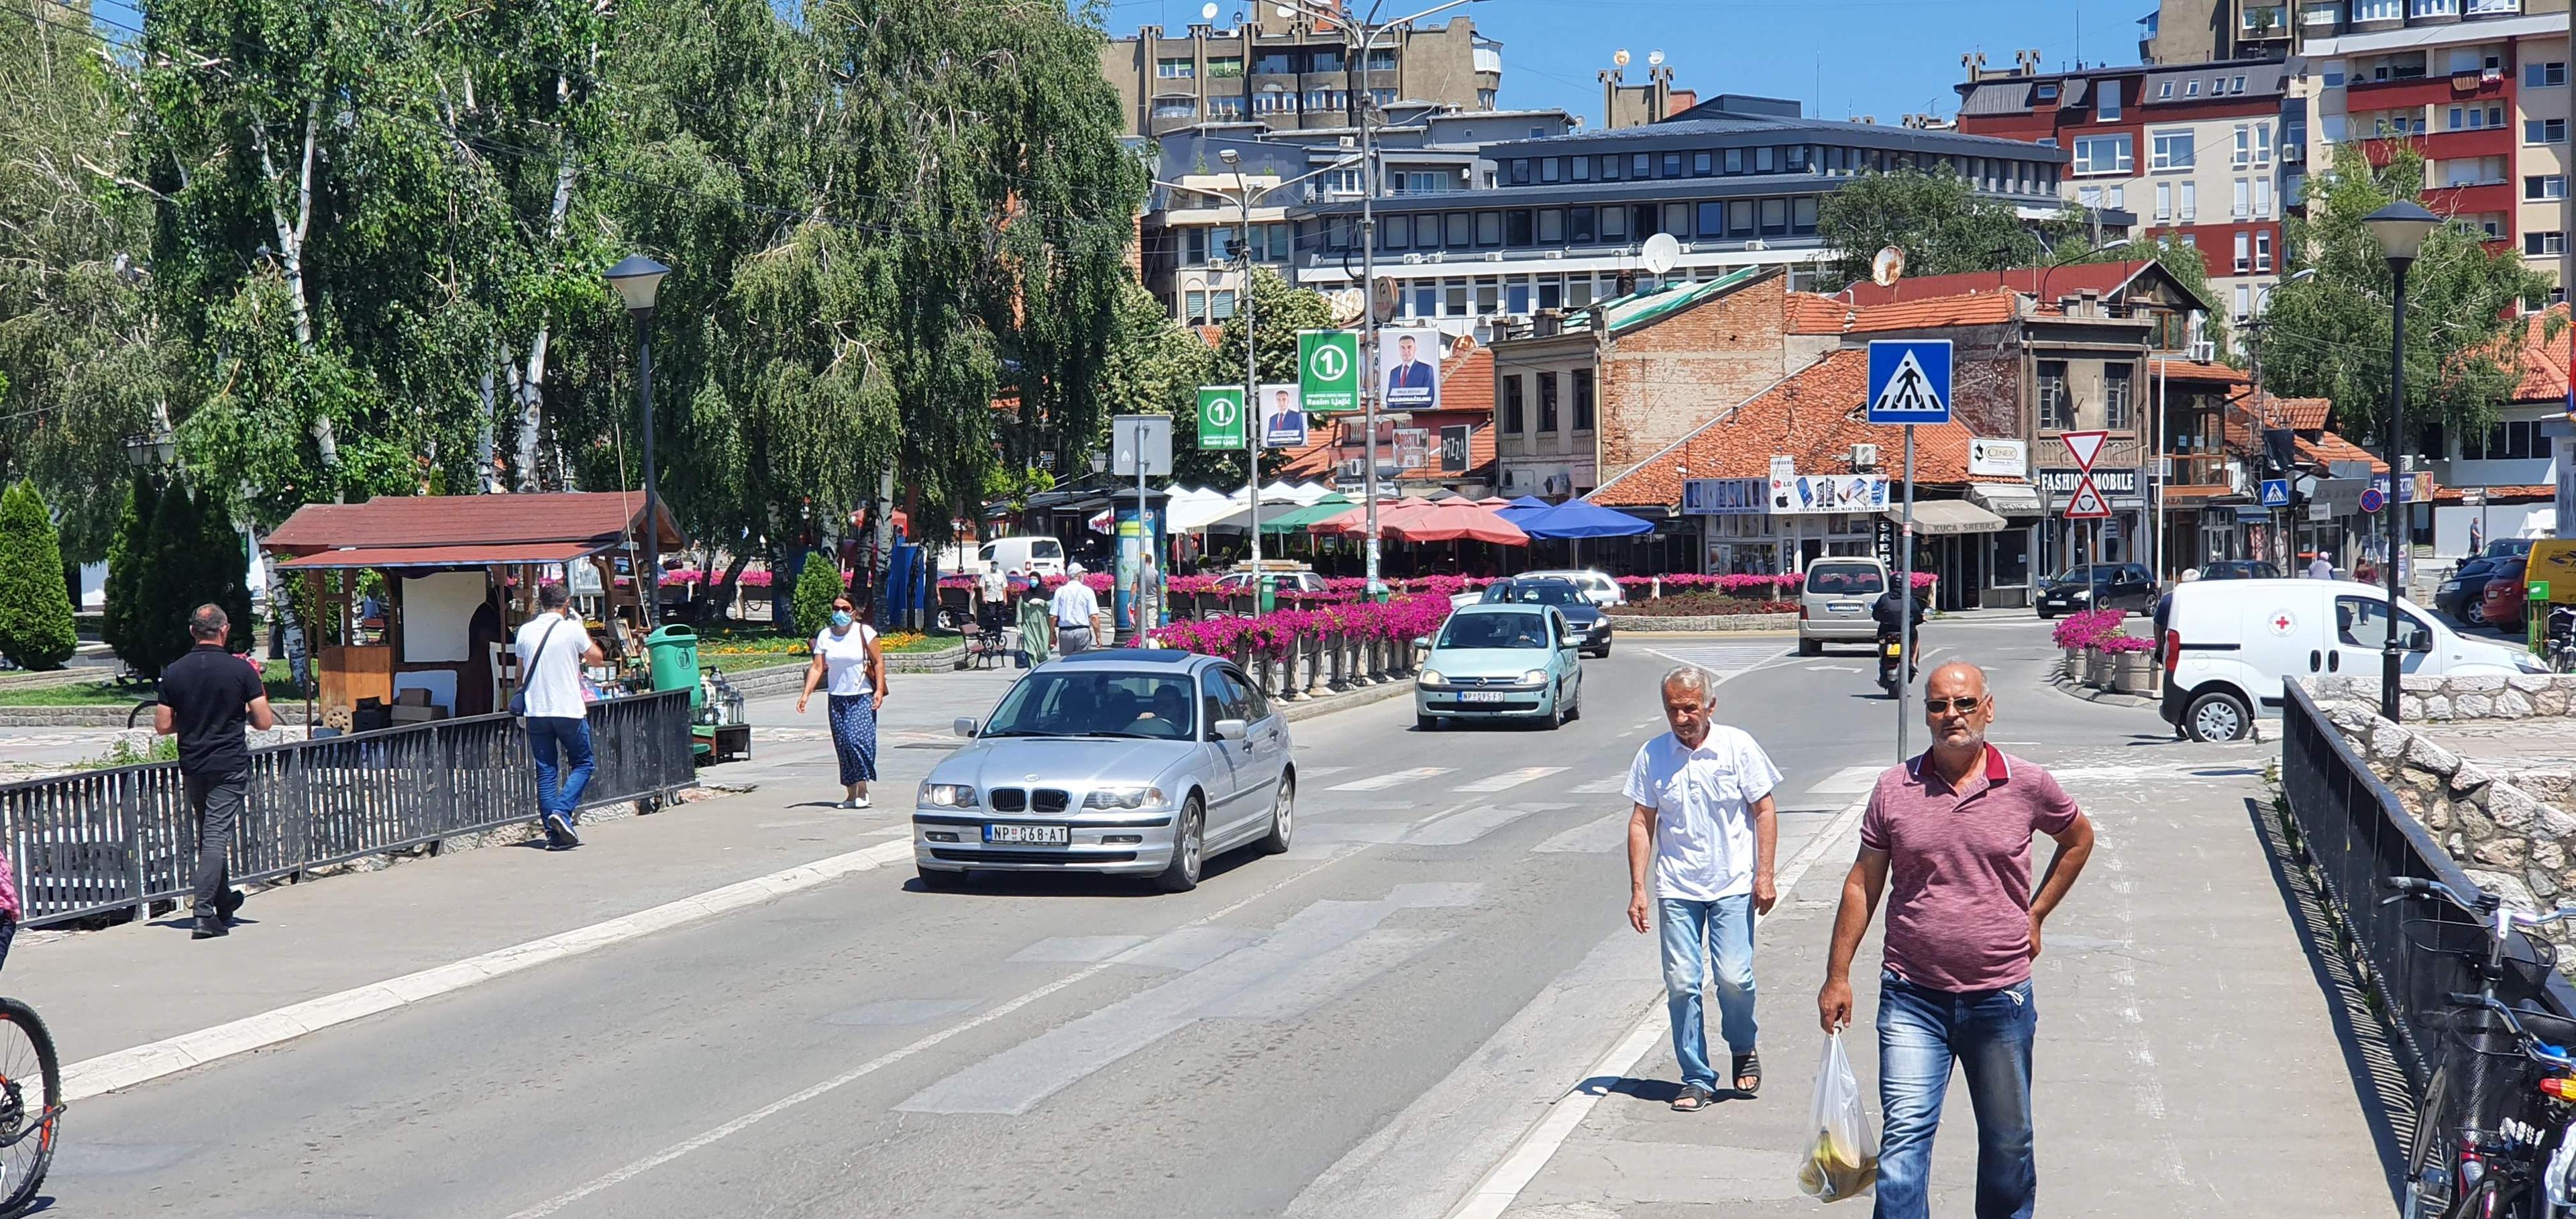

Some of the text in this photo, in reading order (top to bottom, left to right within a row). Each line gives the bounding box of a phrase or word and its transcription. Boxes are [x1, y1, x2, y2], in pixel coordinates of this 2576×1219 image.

[2041, 474, 2134, 491] FASHIO MOBILE
[1964, 523, 1996, 531] SREBRA
[994, 827, 1009, 840] NP
